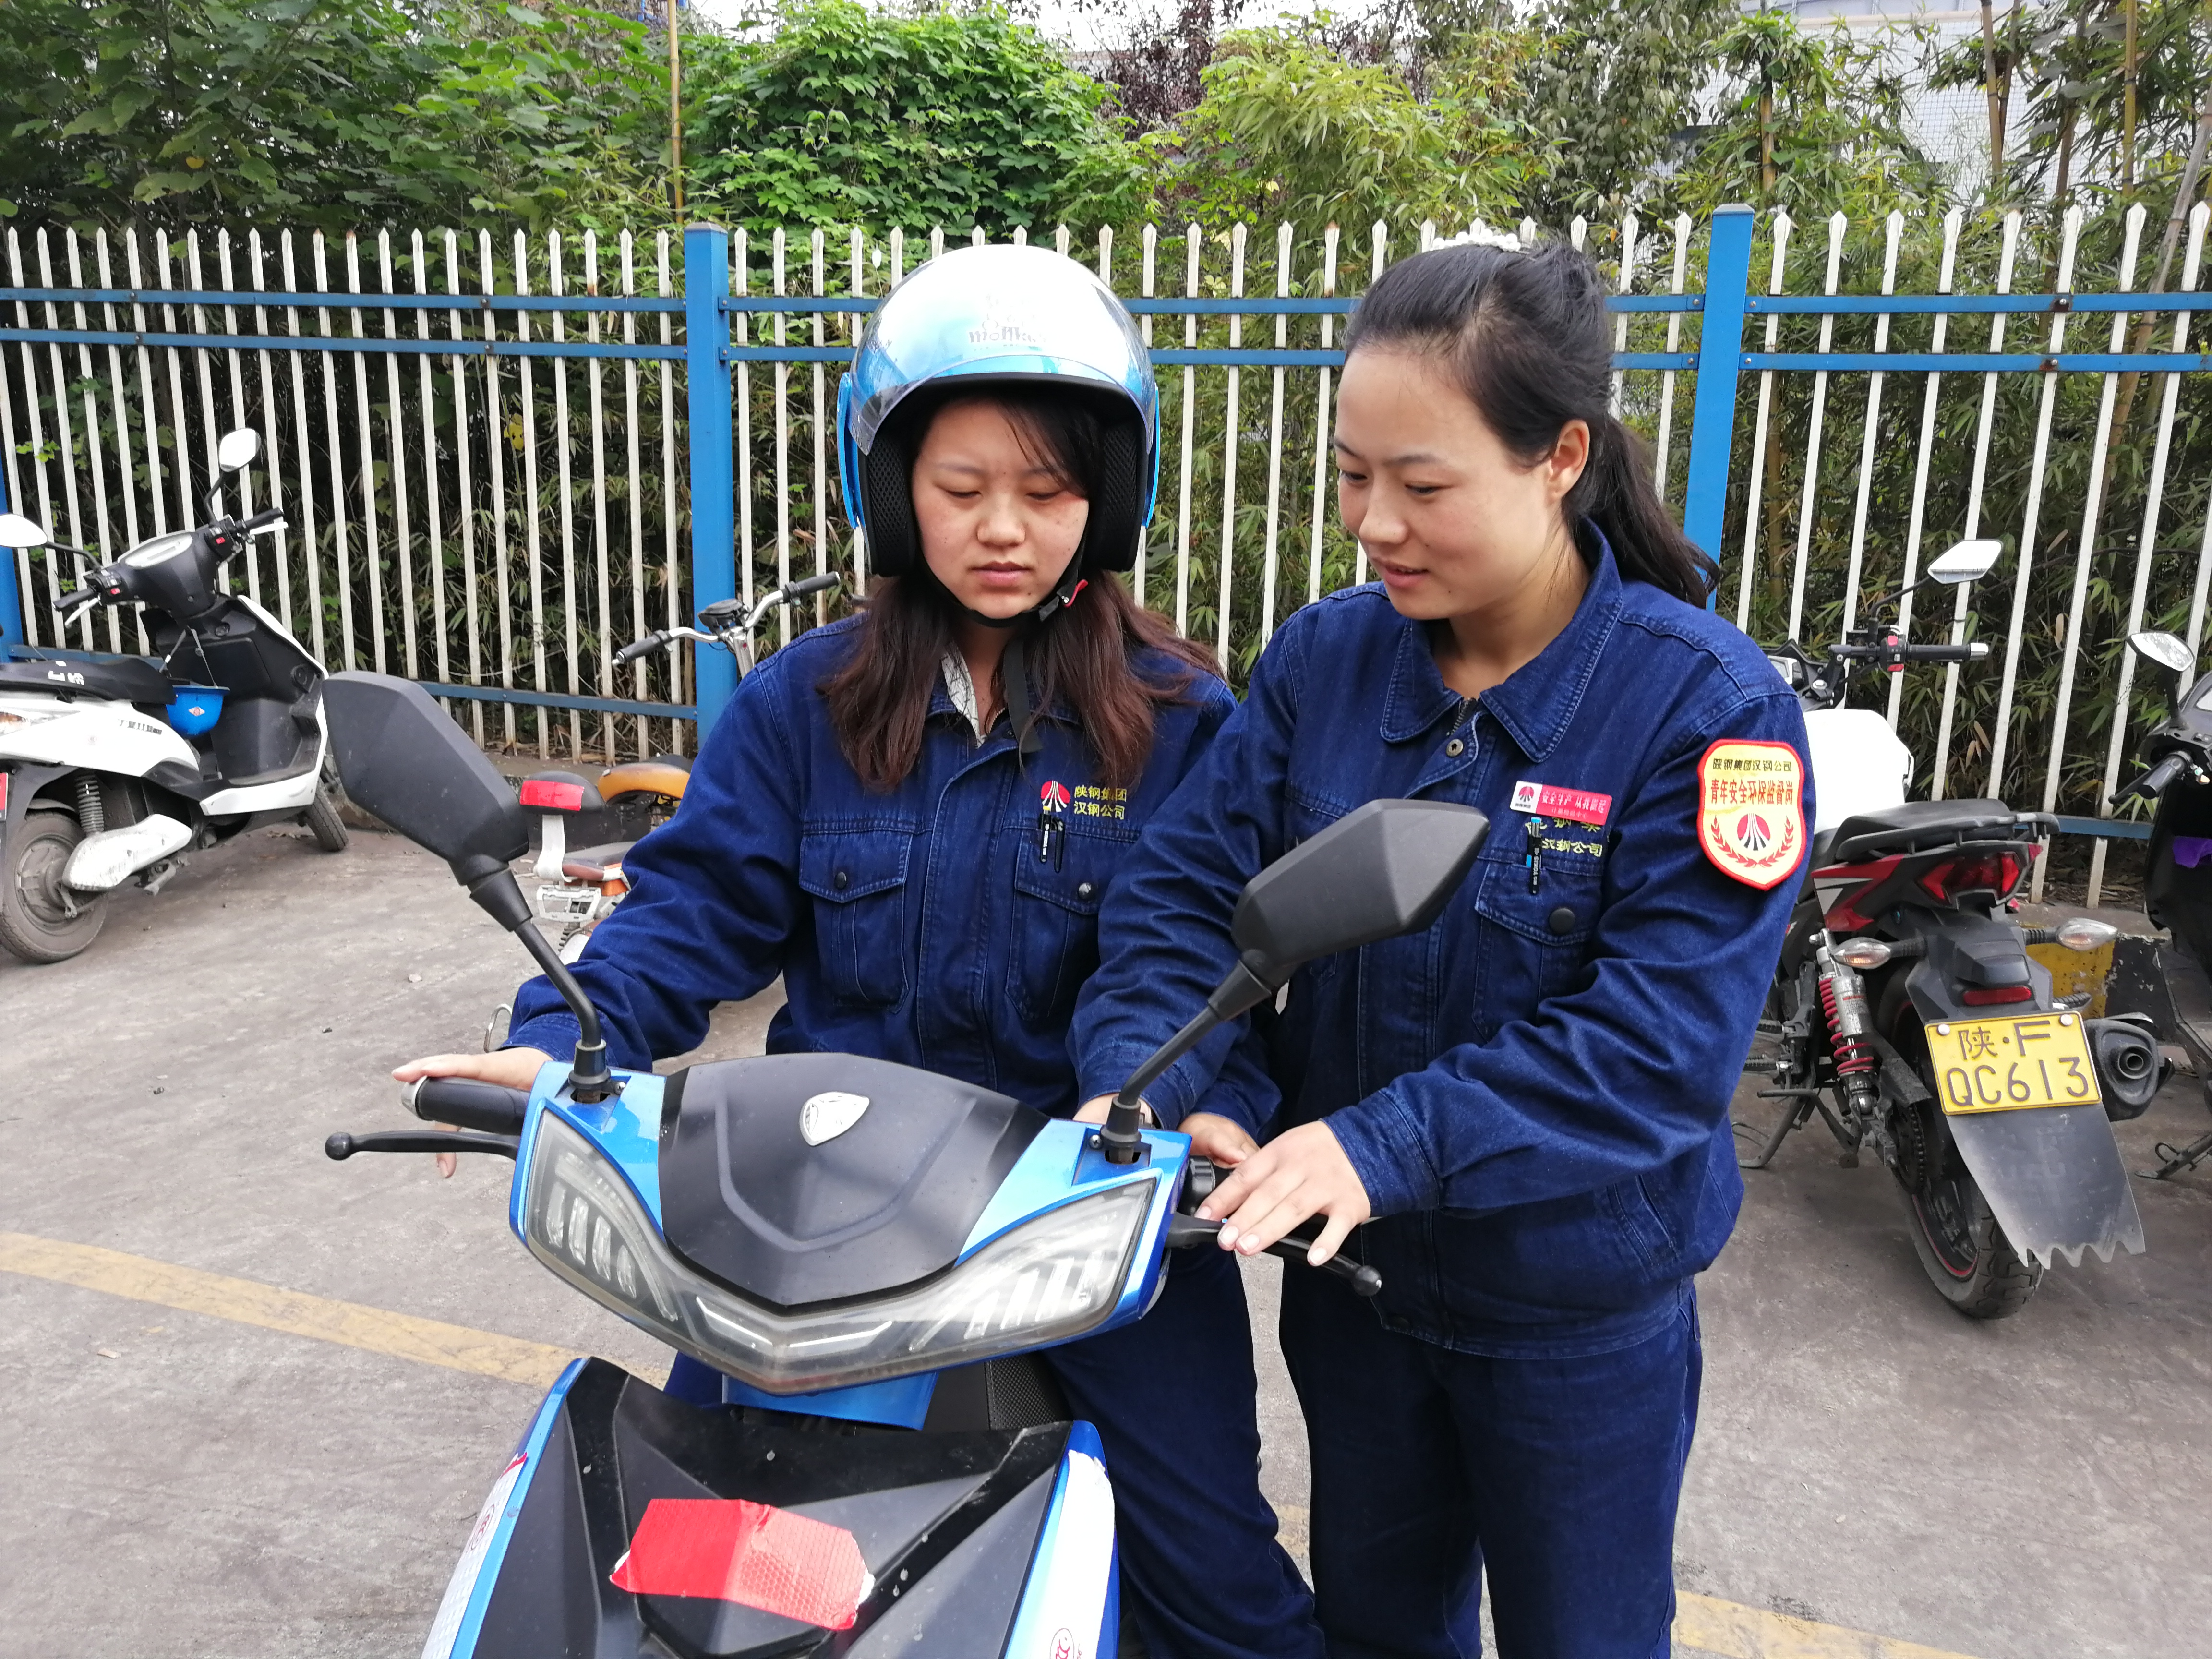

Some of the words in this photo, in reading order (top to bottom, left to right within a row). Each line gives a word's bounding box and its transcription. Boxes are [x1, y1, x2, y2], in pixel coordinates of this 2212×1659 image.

[1713, 758, 1792, 771] 陕钢集团汉钢公司
[1710, 779, 1793, 805] 青年安全环保监督岗
[1074, 801, 1125, 819] 汉钢公司
[1958, 1021, 2051, 1060] 陕·F
[1947, 1057, 2089, 1106] QC613
